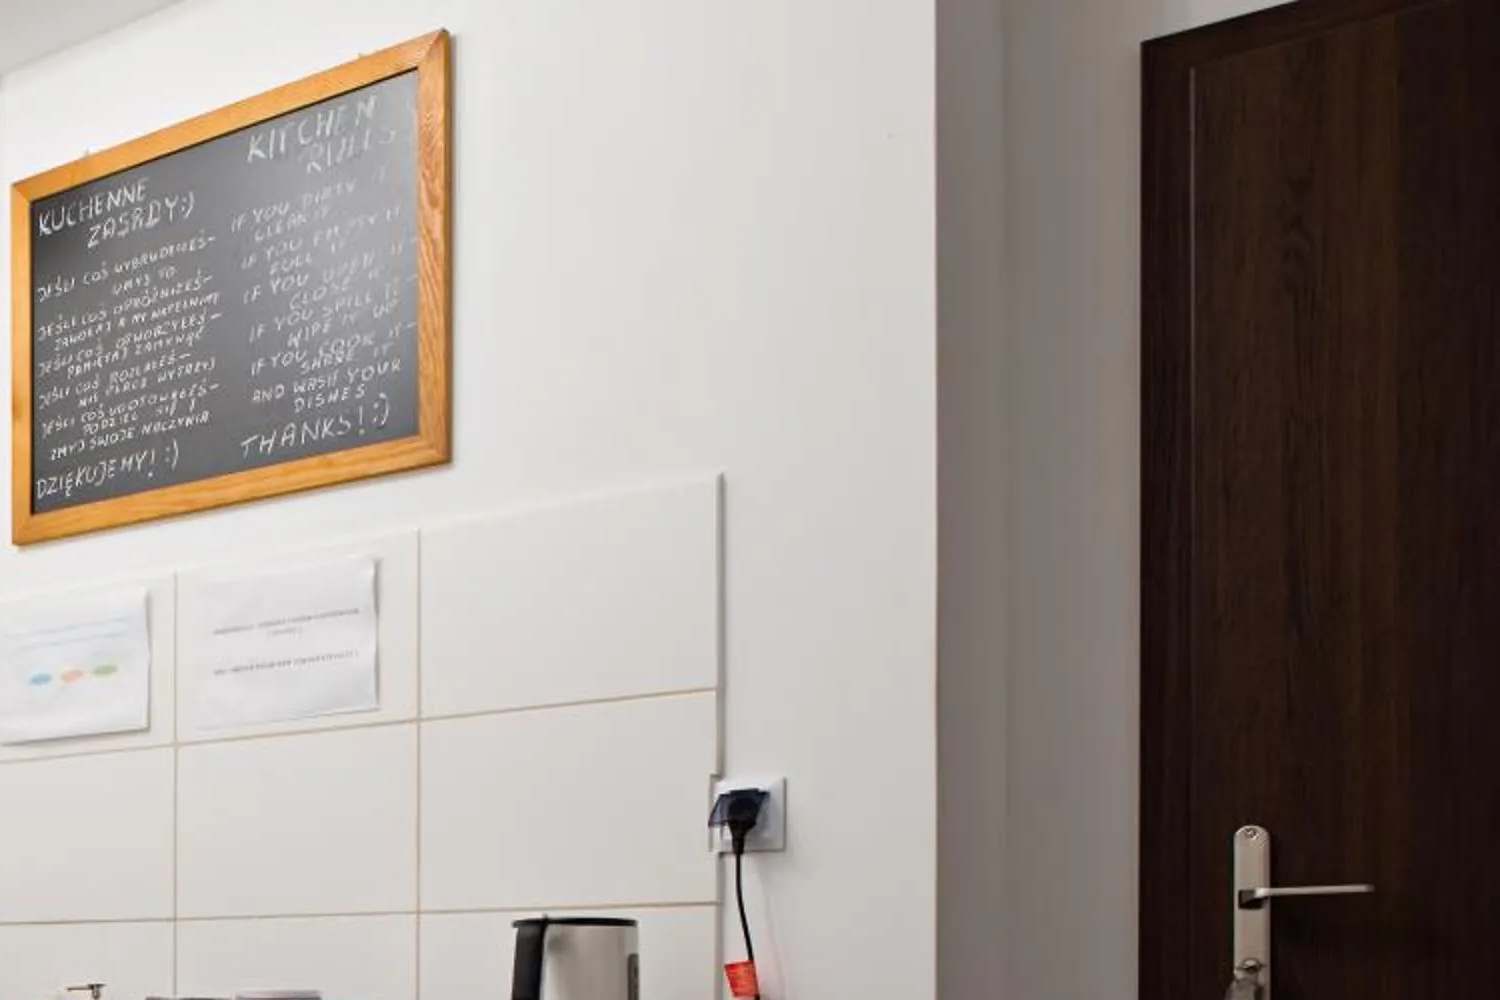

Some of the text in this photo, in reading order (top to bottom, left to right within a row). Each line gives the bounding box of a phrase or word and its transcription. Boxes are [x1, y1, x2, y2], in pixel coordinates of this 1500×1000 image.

[247, 95, 376, 164] KITCHEN
[39, 176, 149, 236] KUCHENNE
[231, 212, 246, 233] IF
[252, 201, 290, 224] YOU
[265, 239, 303, 262] YOU
[243, 284, 262, 305] IF
[269, 273, 309, 296] YOU
[249, 323, 267, 345] IF
[273, 308, 314, 332] YOU
[251, 357, 266, 378] IF
[270, 349, 307, 369] YOU
[253, 358, 402, 403] AND WASH YOUR
[293, 382, 367, 414] DISHES
